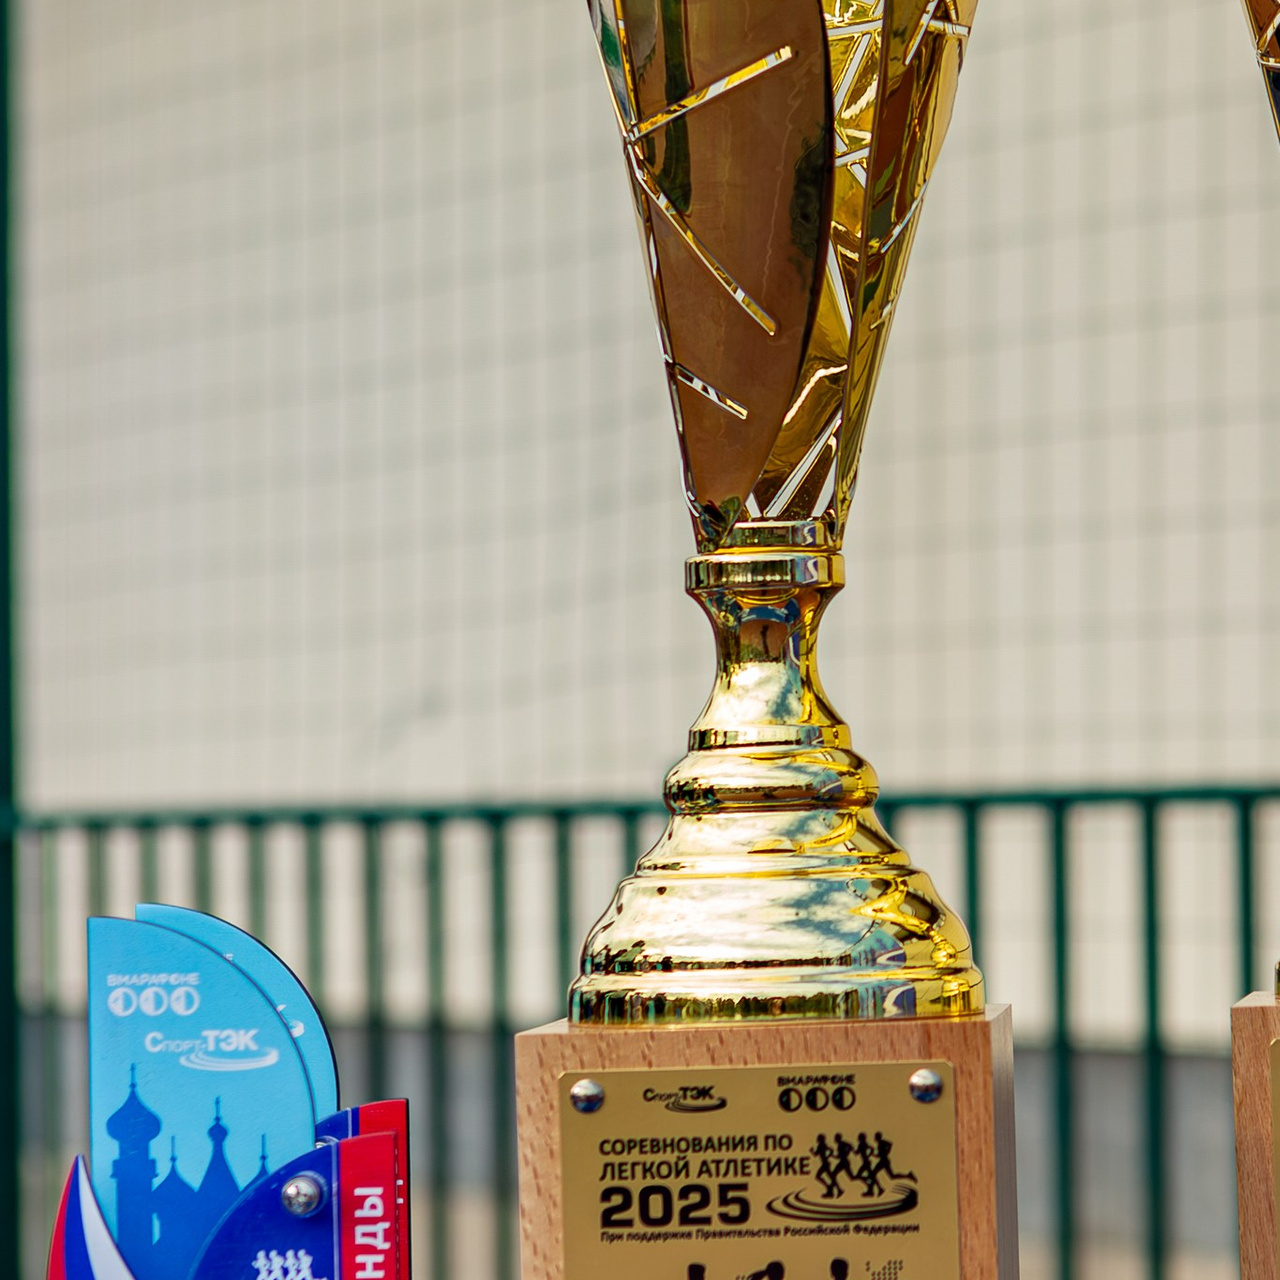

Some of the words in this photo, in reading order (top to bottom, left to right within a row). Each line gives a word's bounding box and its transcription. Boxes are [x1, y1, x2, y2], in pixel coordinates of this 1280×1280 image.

[599, 1135, 758, 1156] СОРЕВНОВАНИЯ
[764, 1134, 793, 1151] ПО
[599, 1156, 690, 1181] ЛЕГКОЙ
[696, 1156, 811, 1180] АТЛЕТИКЕ
[600, 1183, 750, 1228] 2025
